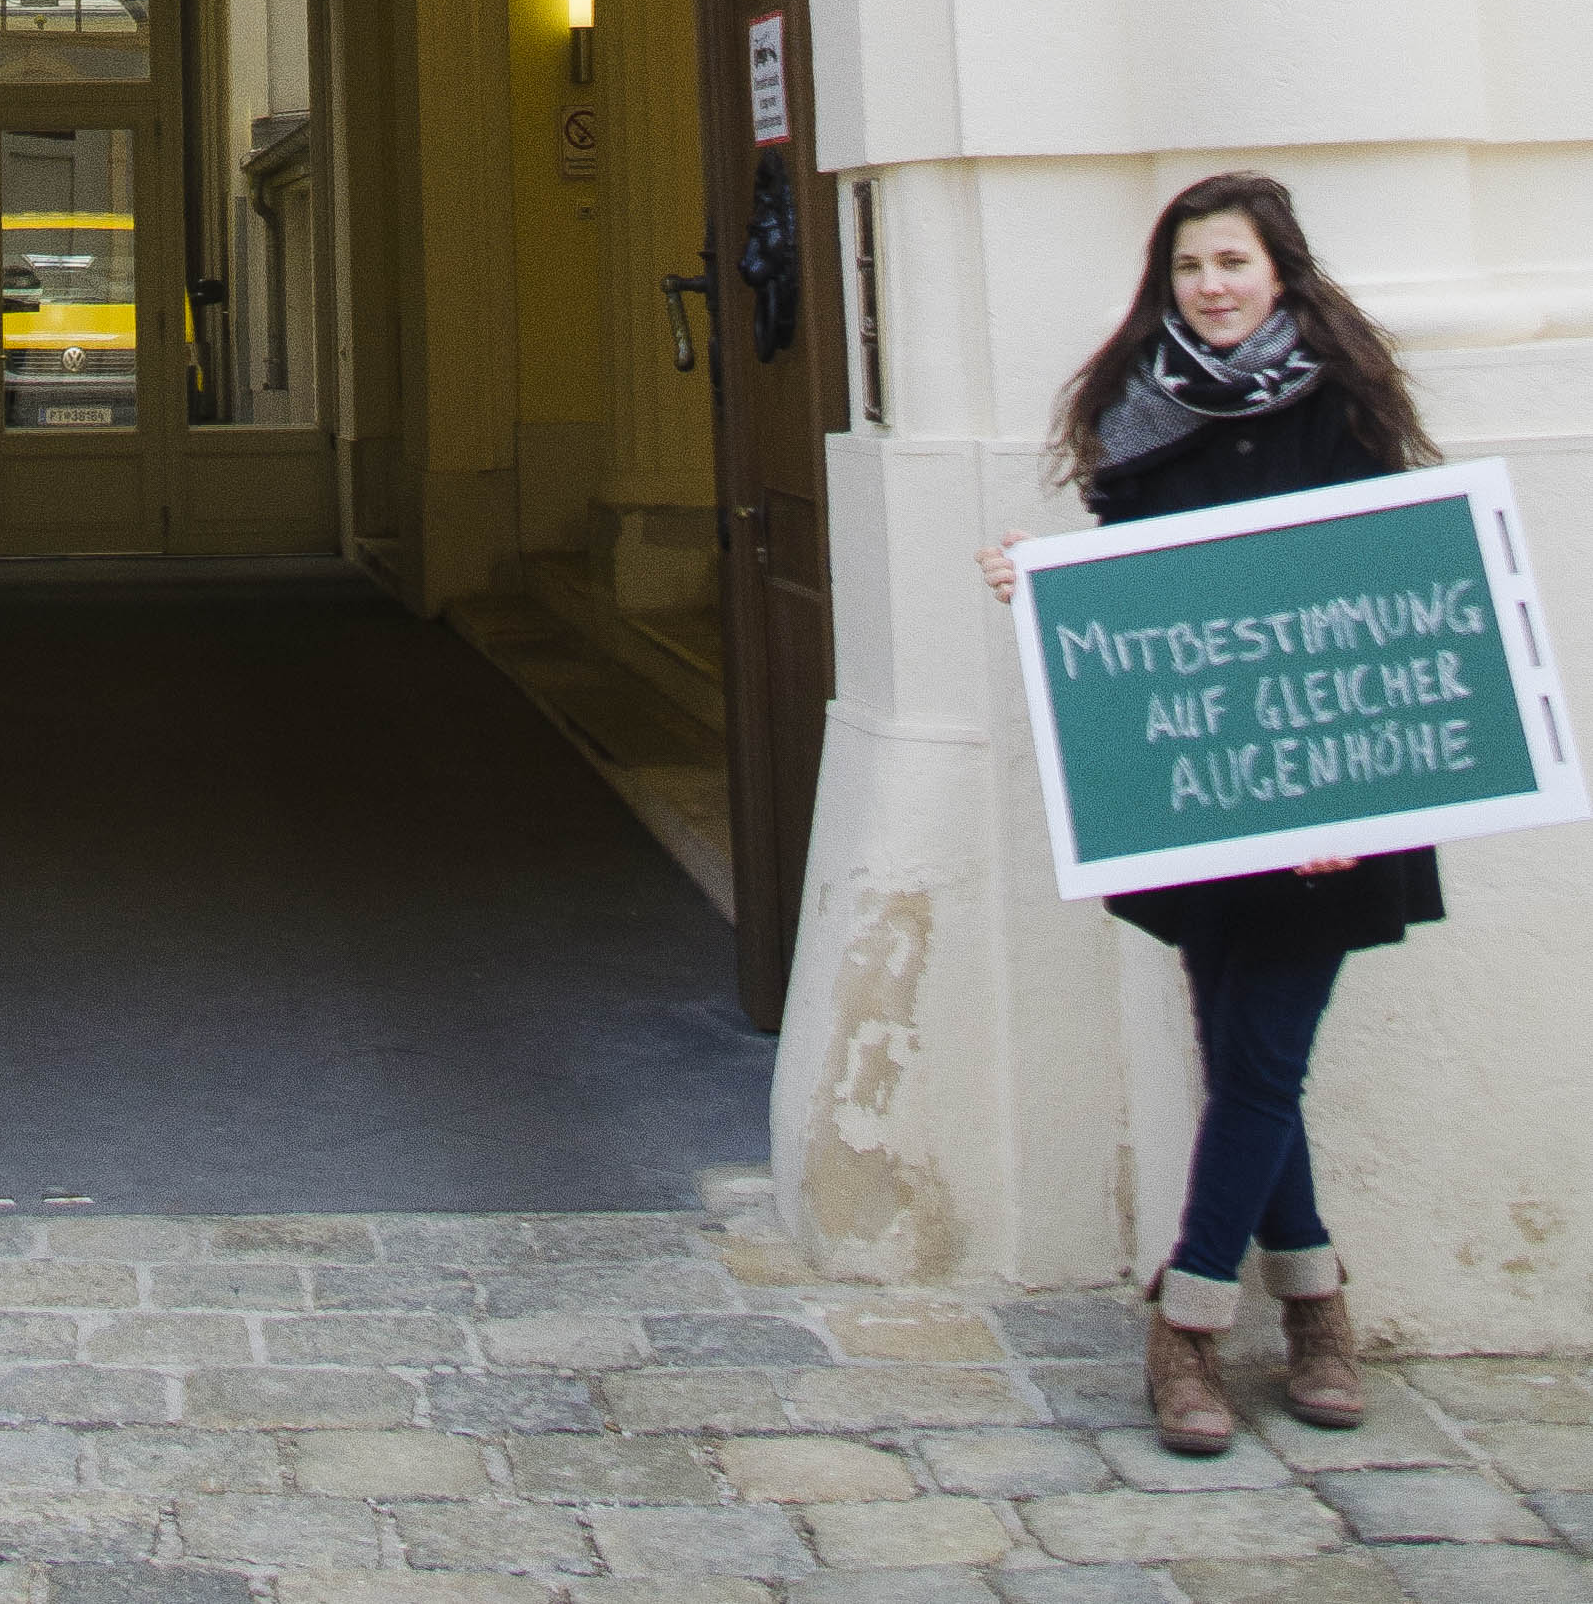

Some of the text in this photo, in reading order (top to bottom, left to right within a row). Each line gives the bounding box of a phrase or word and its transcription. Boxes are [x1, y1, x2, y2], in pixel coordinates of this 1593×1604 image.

[1055, 578, 1486, 680] MITBESTIMMUNG
[1146, 650, 1473, 743] AUF GLEICHER
[1170, 718, 1476, 812] AUGENHÖHE
